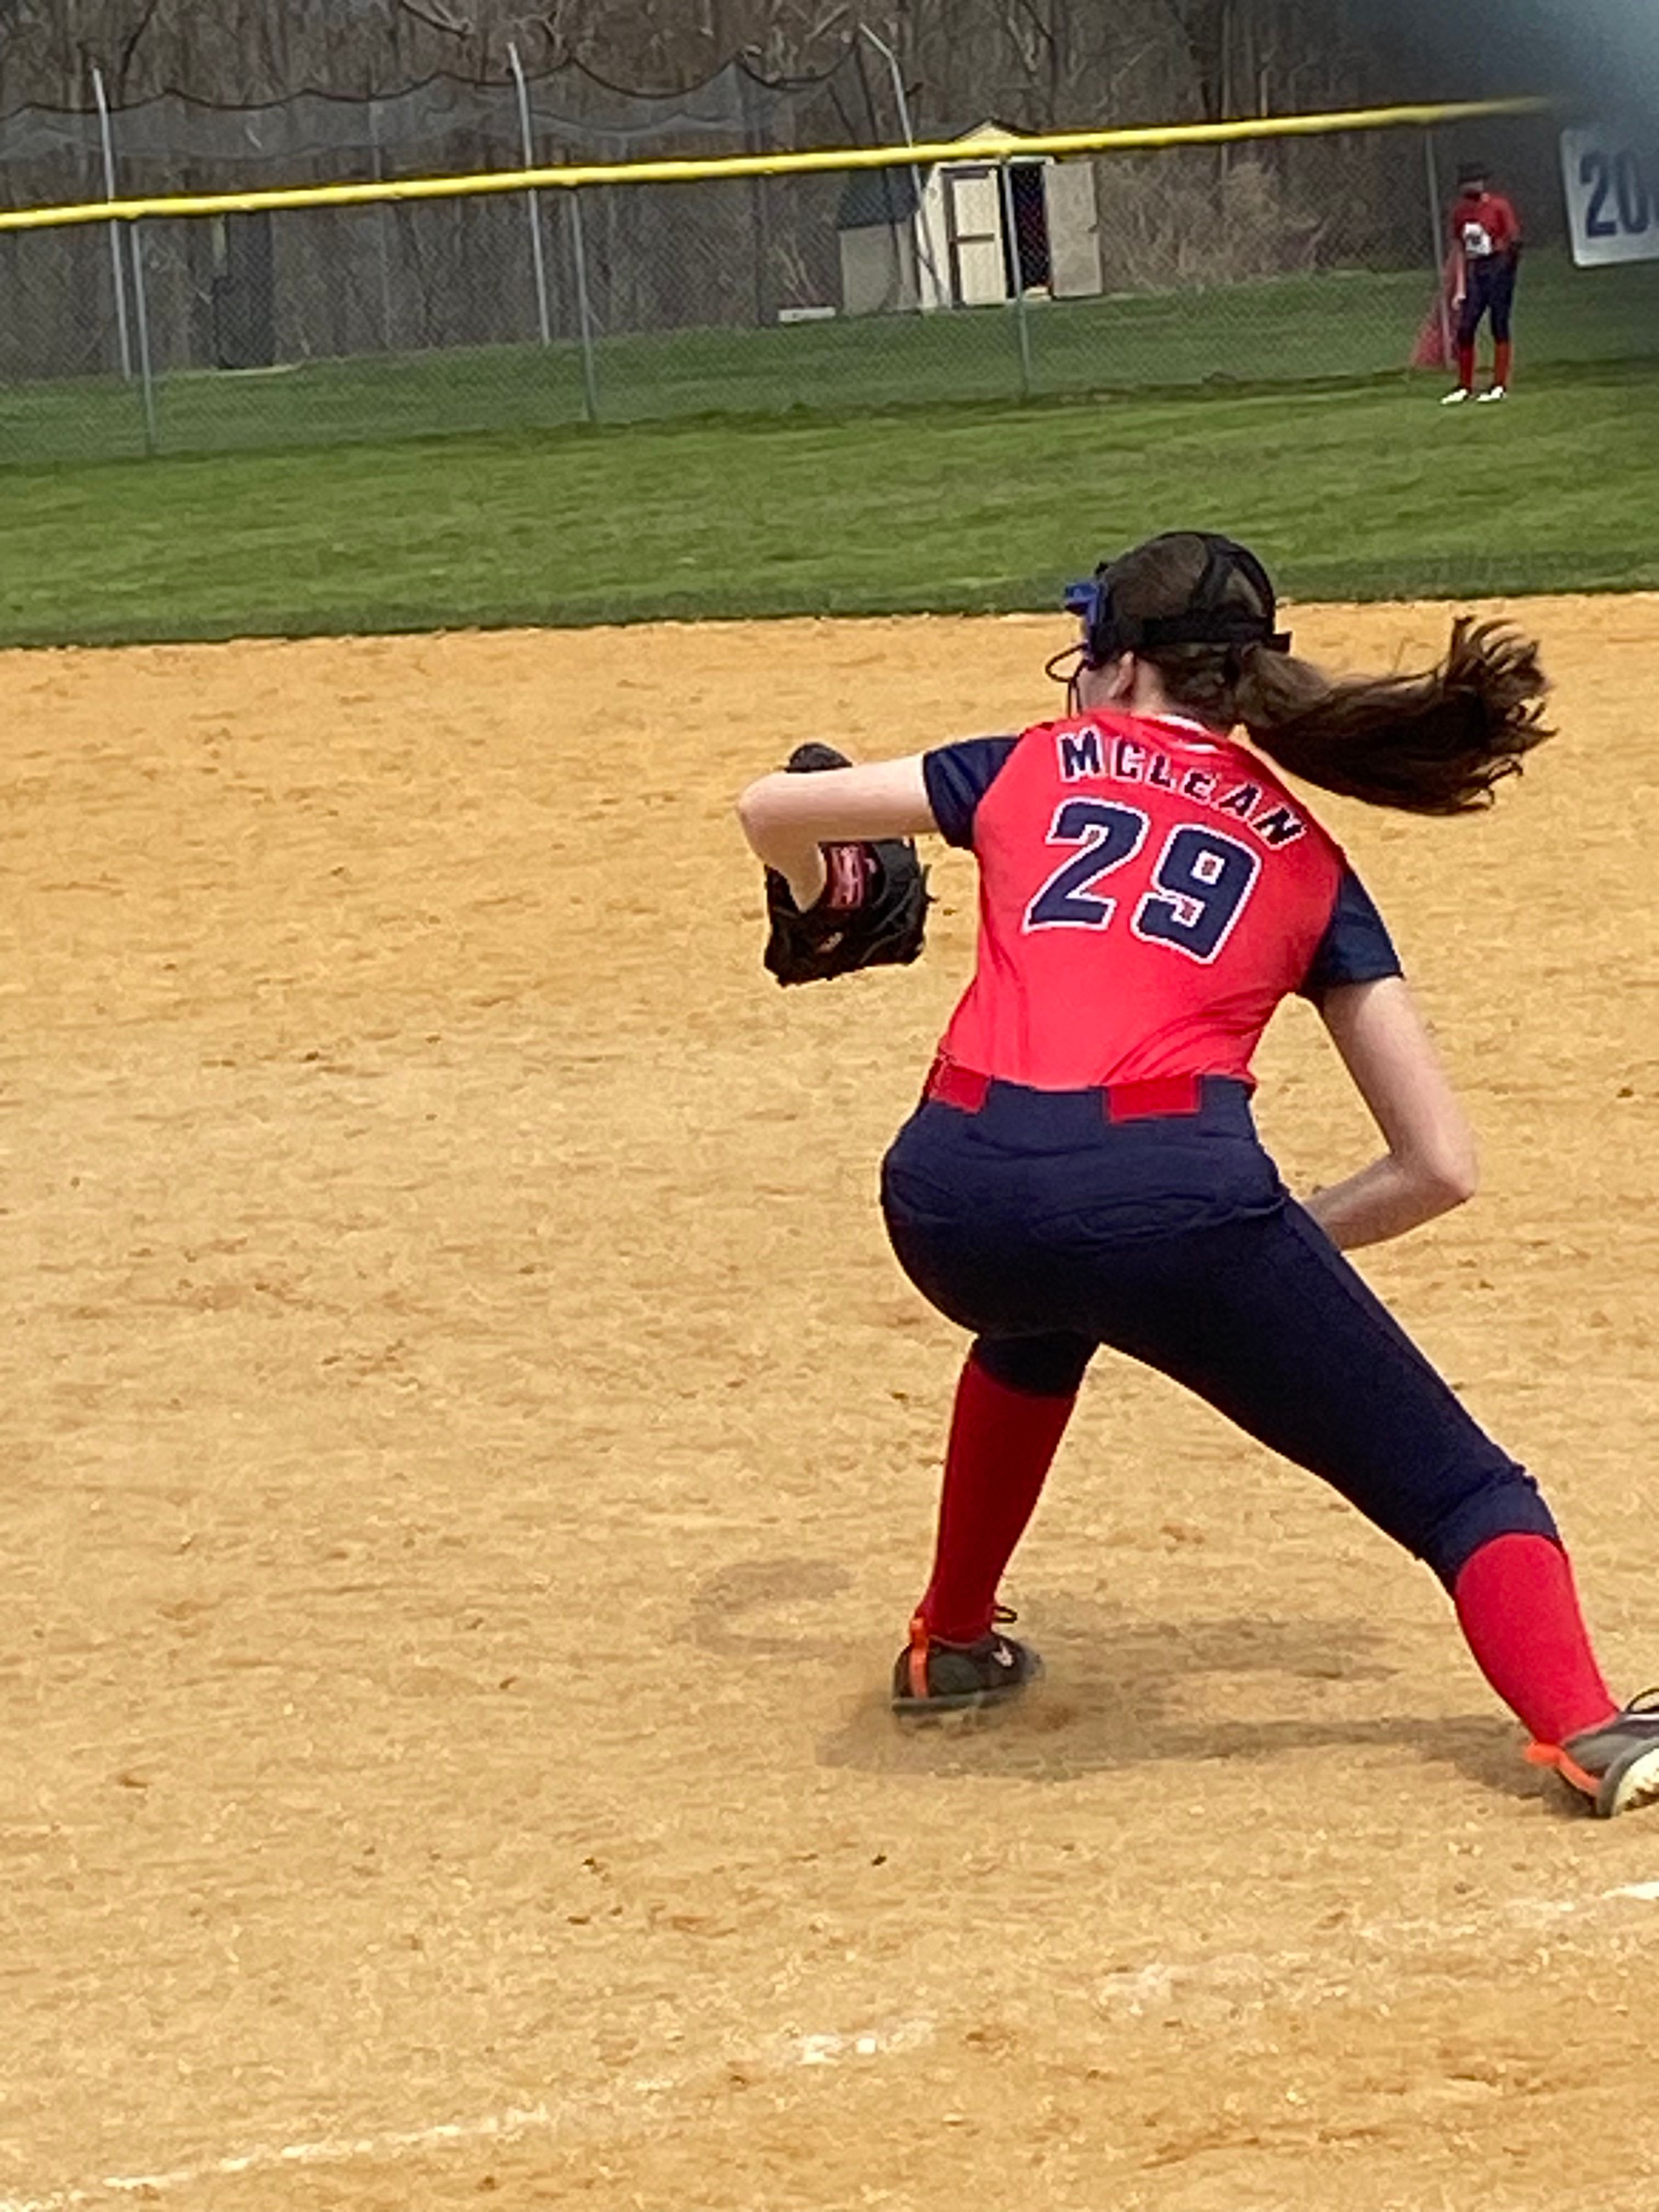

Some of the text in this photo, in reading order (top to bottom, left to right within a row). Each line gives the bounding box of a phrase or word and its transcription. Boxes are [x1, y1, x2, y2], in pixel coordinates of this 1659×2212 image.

[1579, 150, 1659, 238] 20
[1057, 725, 1307, 850] MCLEAN
[1022, 796, 1262, 964] 29
